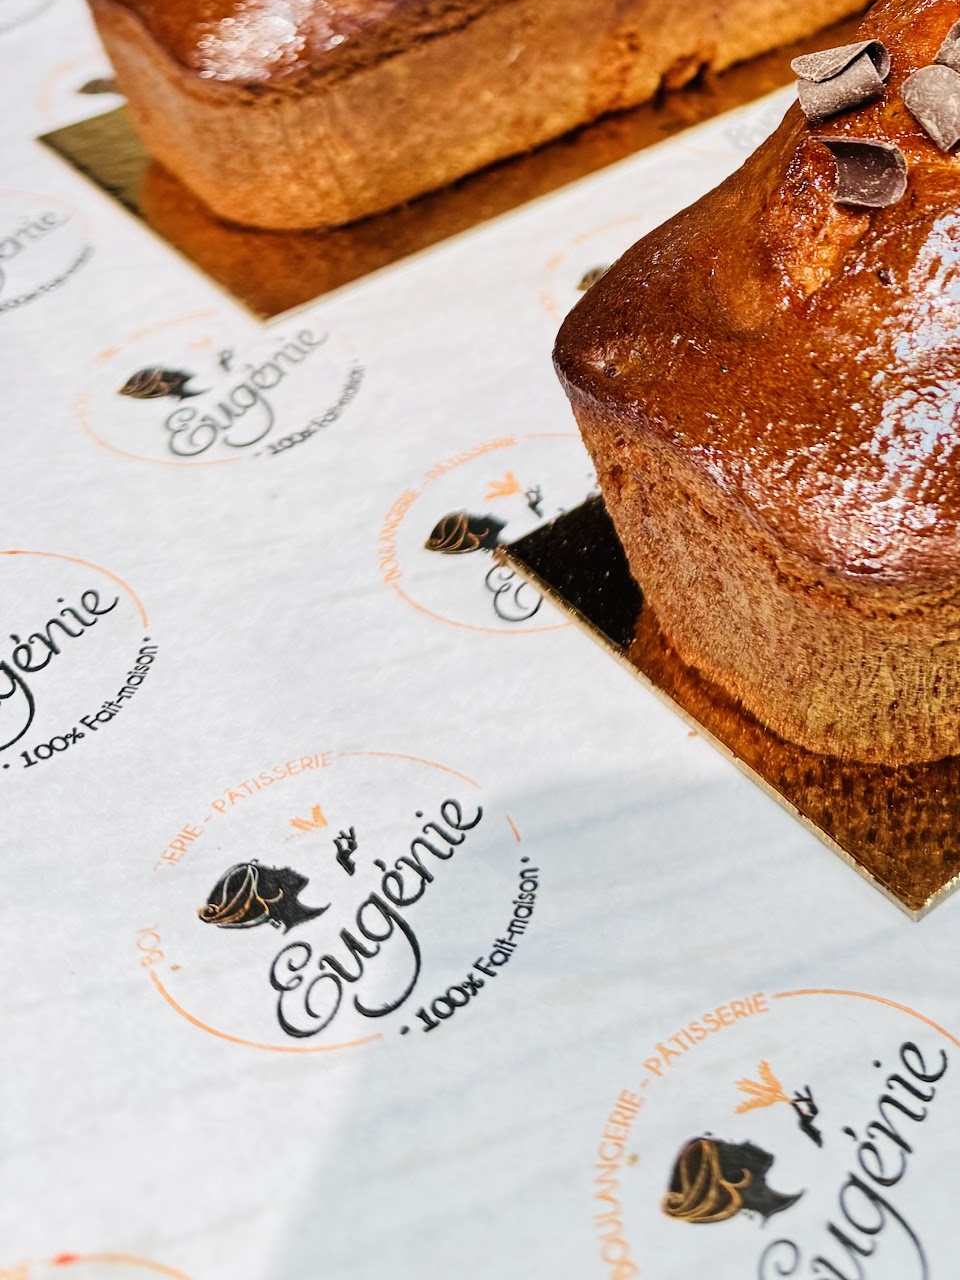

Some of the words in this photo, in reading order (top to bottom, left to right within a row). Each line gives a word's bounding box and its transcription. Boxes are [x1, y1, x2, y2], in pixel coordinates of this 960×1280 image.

[20, 727, 86, 768] 100%
[79, 645, 159, 731] Fait-maison
[211, 751, 334, 814] PÂTISSERIE
[270, 799, 483, 1038] Eugénie
[415, 972, 485, 1033] 100%
[472, 867, 541, 978] Fait-maison
[643, 992, 770, 1077] PÂTISSERIE
